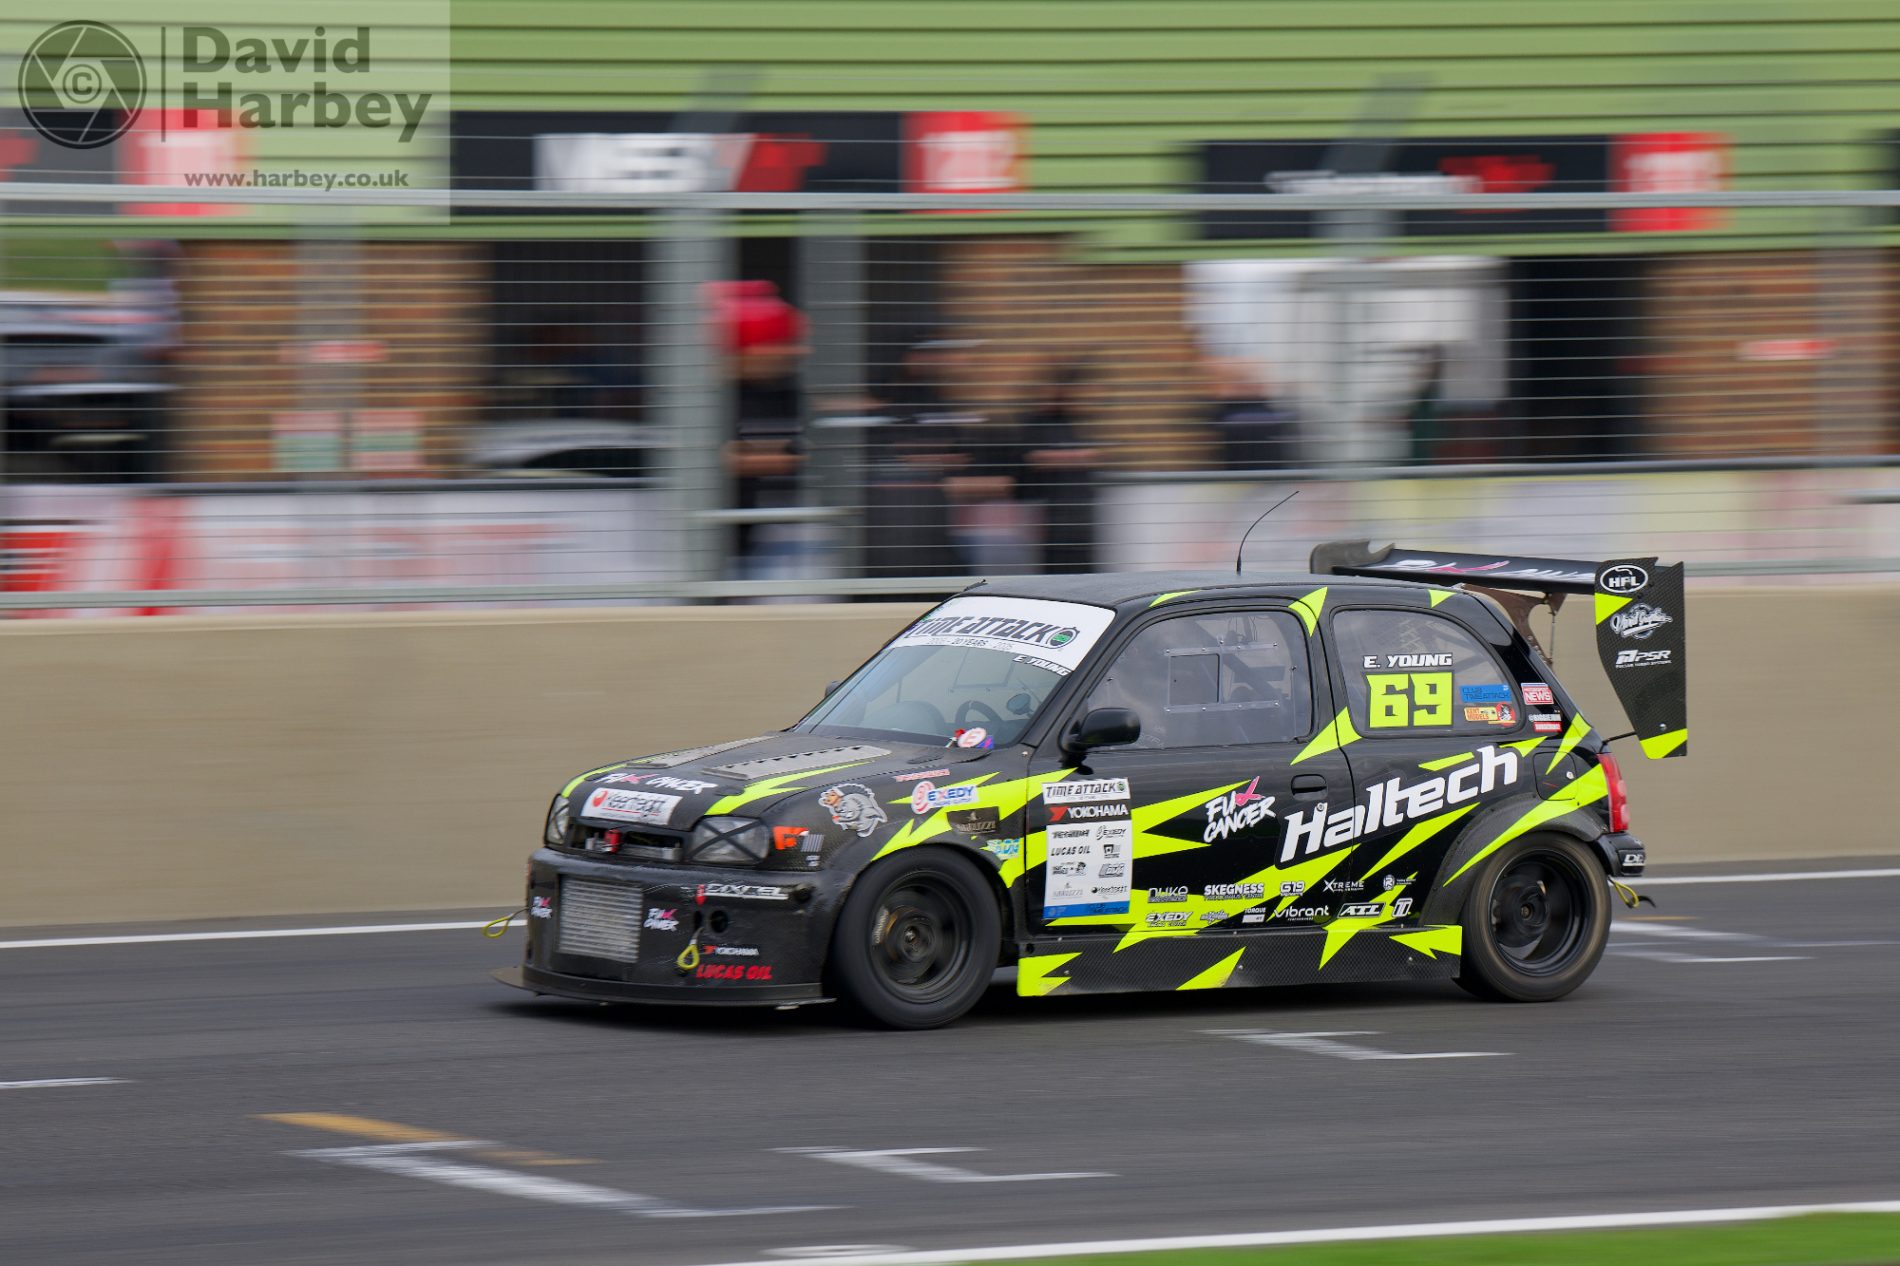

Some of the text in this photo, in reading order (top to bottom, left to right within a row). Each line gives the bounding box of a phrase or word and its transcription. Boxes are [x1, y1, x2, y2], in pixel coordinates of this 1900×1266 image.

[1608, 576, 1641, 588] HFL
[1387, 653, 1452, 668] YOUNG
[1366, 672, 1452, 728] 69
[1524, 691, 1552, 701] NEWS
[928, 786, 974, 801] EXEDY
[1068, 804, 1129, 819] YOKOHAMA
[1280, 745, 1518, 863] Haltech
[1203, 795, 1276, 843] CANCER
[1050, 845, 1091, 856] LUCAS OIL
[1204, 883, 1265, 896] SKEGNESS
[1146, 911, 1193, 922] EXEDY
[697, 964, 773, 980] LUCAS OIL
